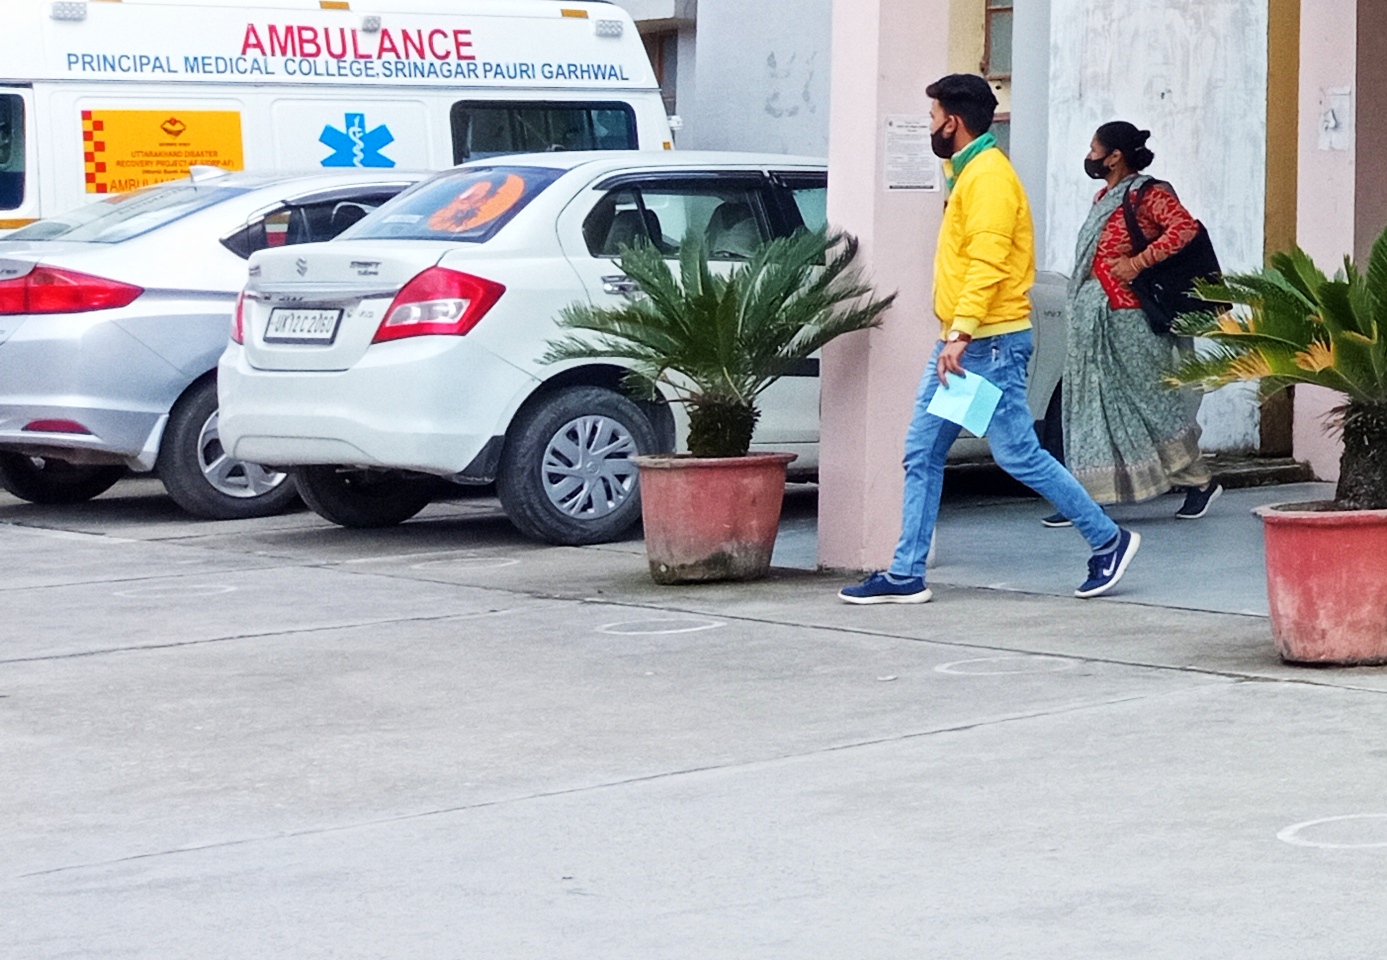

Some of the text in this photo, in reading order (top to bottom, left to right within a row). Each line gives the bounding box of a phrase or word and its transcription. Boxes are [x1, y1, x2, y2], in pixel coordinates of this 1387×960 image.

[241, 23, 477, 61] AMBULANCE
[67, 53, 178, 74] PRINCIPAL
[183, 56, 276, 76] MEDICAL
[483, 62, 536, 81] PAURI
[542, 63, 630, 82] GARHWAL
